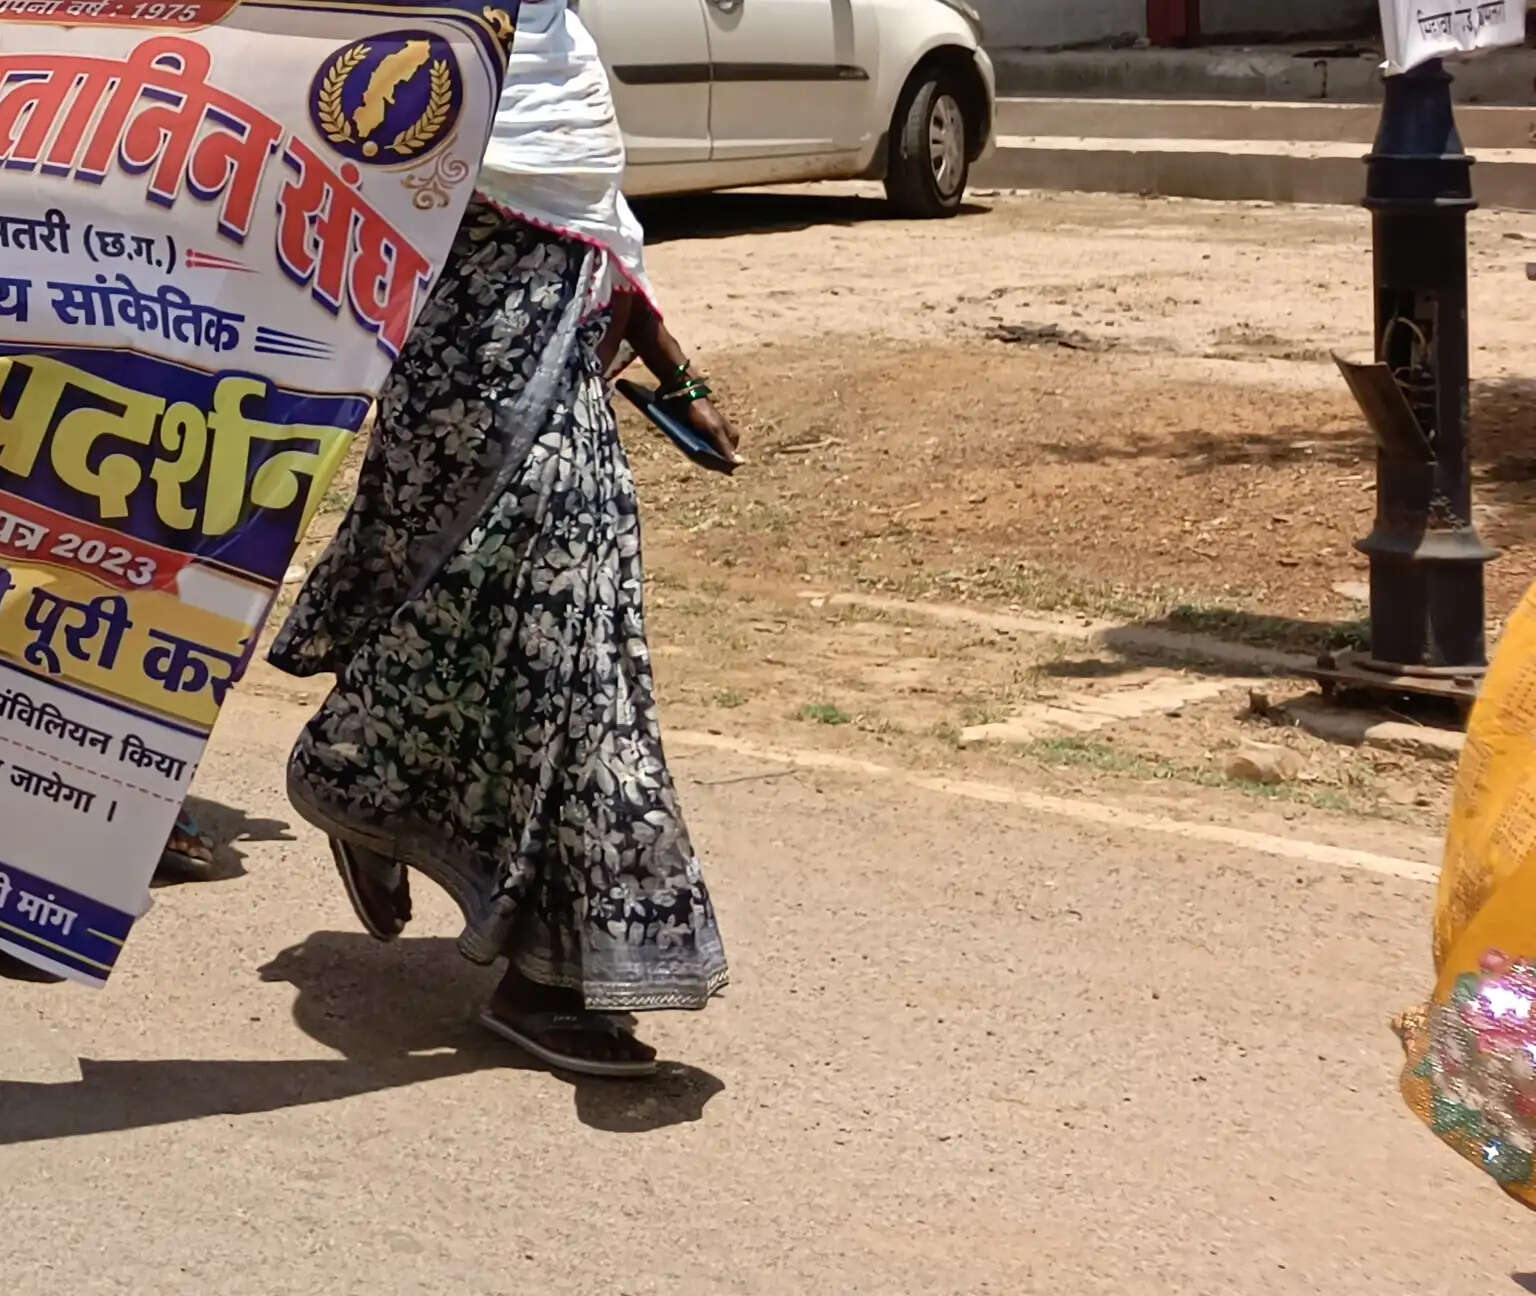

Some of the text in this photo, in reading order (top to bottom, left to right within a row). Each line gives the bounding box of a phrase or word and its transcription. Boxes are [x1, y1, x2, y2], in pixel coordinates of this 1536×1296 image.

[130, 2, 202, 23] 1975
[82, 224, 177, 275] (छ.ग.)
[277, 135, 435, 359] संघ
[46, 273, 246, 353] सांकेतिक
[50, 533, 158, 586] 2023
[23, 586, 134, 675] पूरी
[118, 733, 188, 783] किया
[9, 764, 97, 814] जायेगा
[15, 891, 78, 936] मांग
